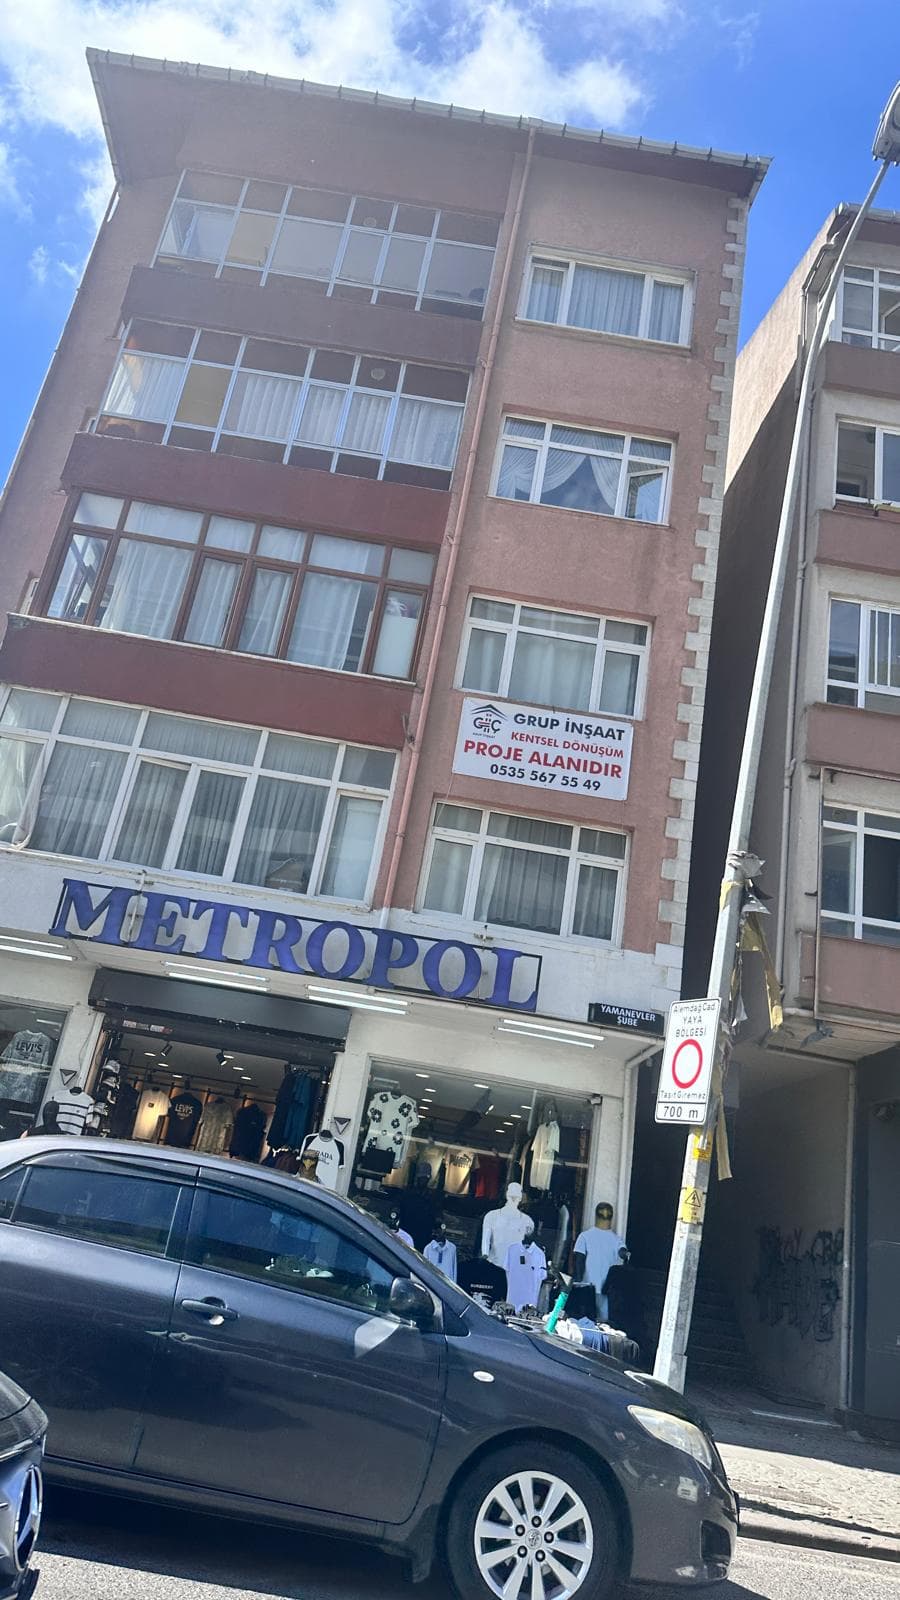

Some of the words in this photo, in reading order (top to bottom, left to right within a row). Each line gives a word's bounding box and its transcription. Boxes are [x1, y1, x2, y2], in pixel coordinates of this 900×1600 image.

[514, 713, 560, 730] GRUP
[565, 718, 625, 741] İNŞAAT
[511, 731, 559, 748] KENTSEL
[562, 739, 624, 758] DÖNÜŞÜM
[464, 740, 523, 762] PROJE
[528, 751, 622, 778] ALANIDIR
[490, 764, 525, 779] 0535
[529, 770, 556, 784] 567
[560, 776, 578, 788] 55
[583, 778, 601, 791] 49
[48, 878, 538, 1012] METROPOL
[600, 1004, 656, 1022] YAMANEVLER
[683, 1015, 702, 1024] YAYA
[664, 1106, 683, 1117] 700
[689, 1109, 698, 1118] m
